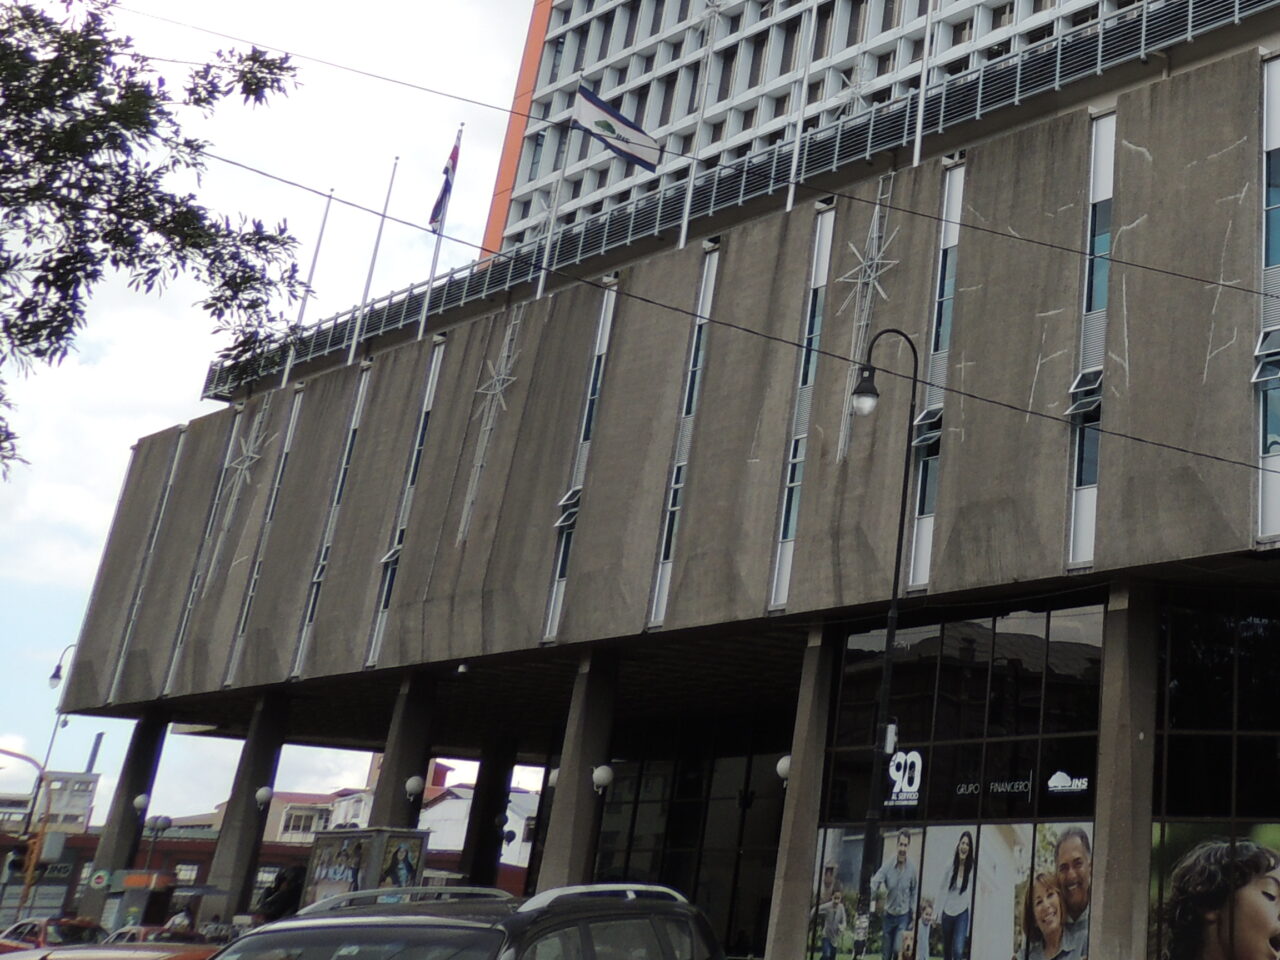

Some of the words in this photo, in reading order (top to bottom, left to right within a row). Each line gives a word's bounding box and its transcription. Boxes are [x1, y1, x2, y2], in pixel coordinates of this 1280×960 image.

[888, 750, 923, 793] 90
[956, 783, 980, 795] GRUPO
[989, 781, 1030, 793] FINANCIERO
[1071, 778, 1088, 790] INS
